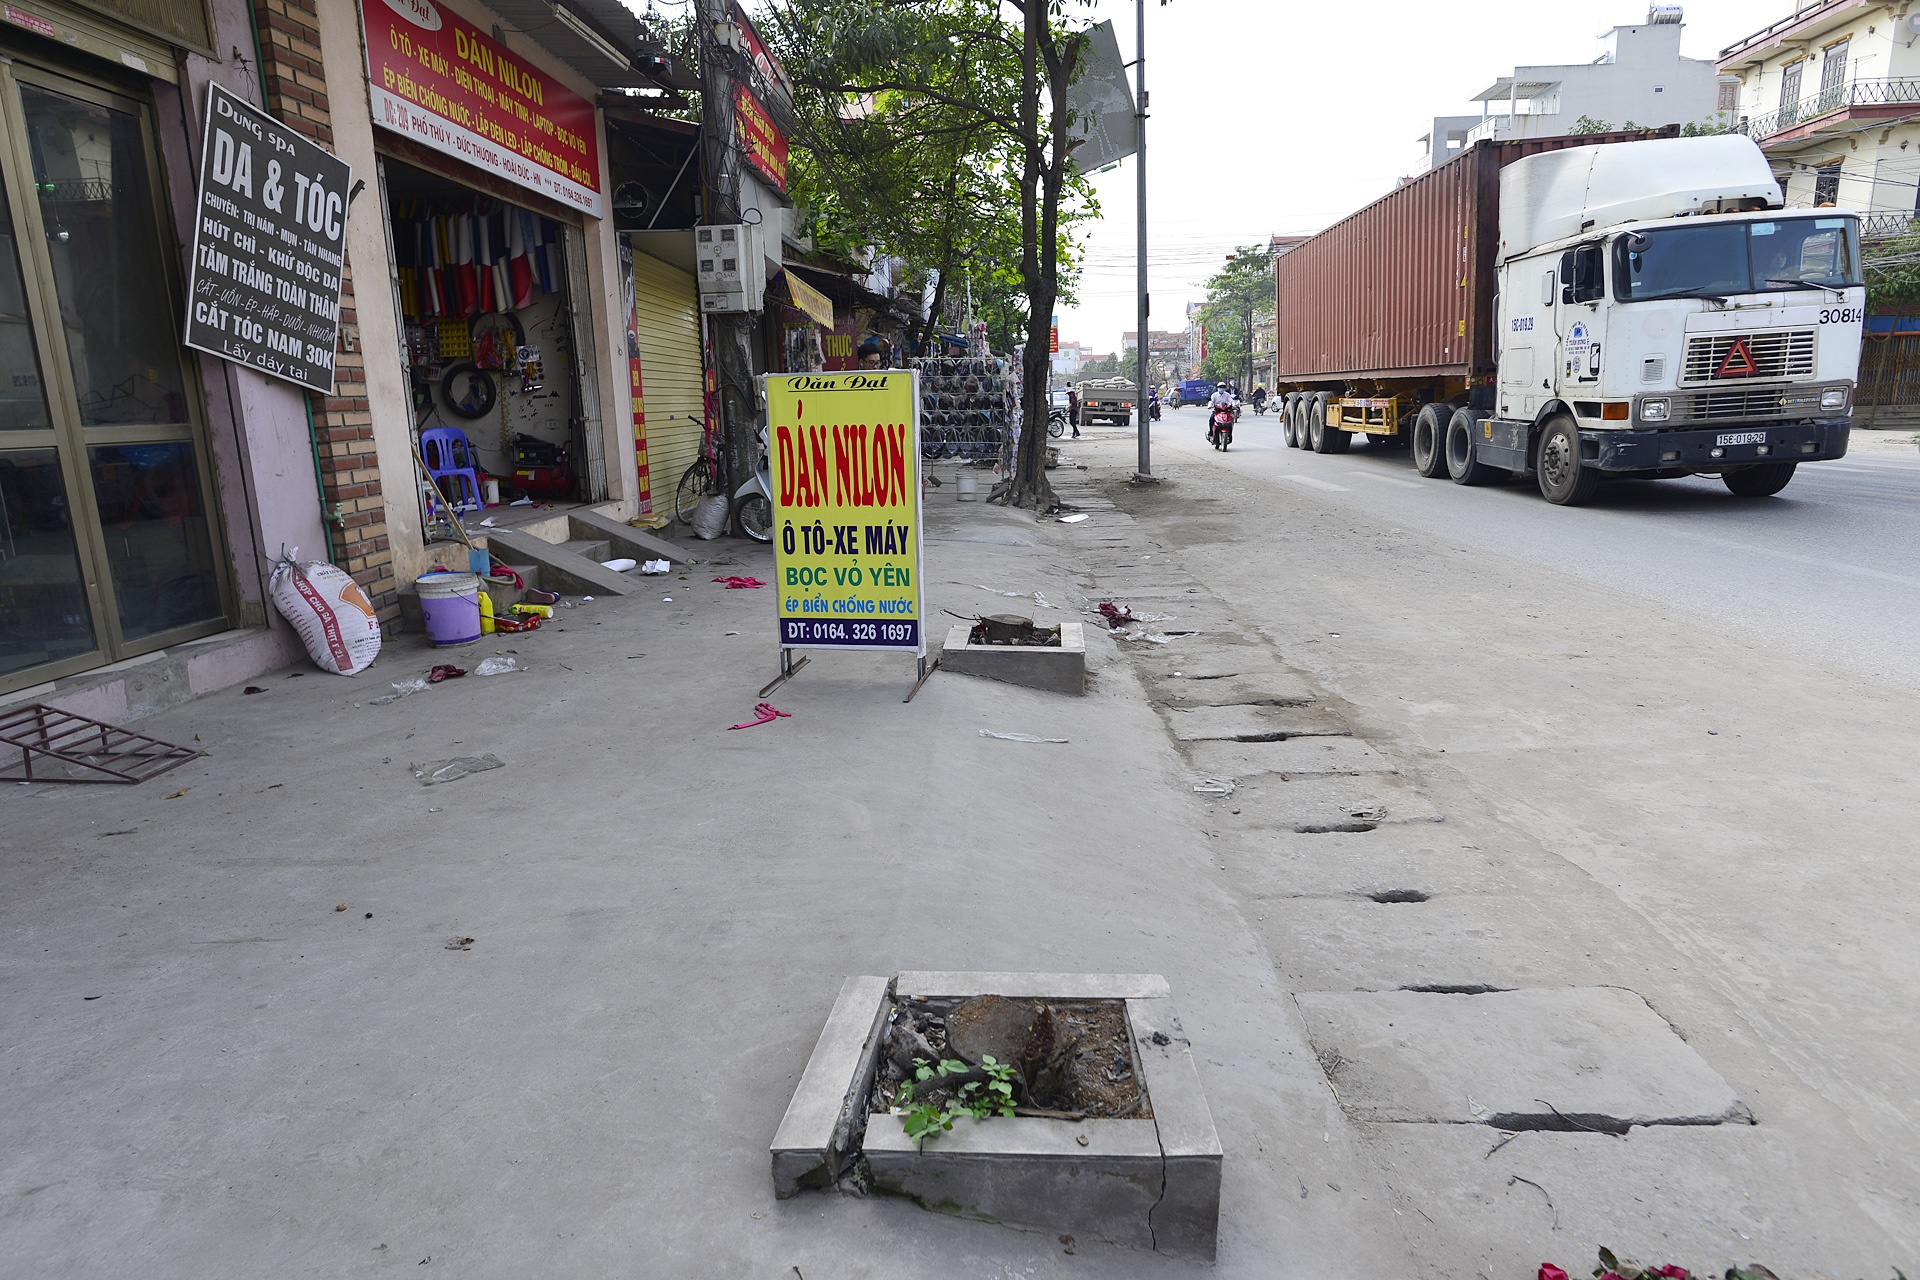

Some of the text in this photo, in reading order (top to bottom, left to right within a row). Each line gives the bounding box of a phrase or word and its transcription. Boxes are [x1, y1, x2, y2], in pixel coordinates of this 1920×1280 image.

[390, 23, 587, 155] Ô TÔ XE MÁY ĐIỆN THOẠI MÁY TÍNH LAPTOP BỌC VỎ YÊN
[454, 27, 543, 107] DÁN NILON
[383, 61, 395, 90] ÉP
[397, 67, 418, 102] BIỂN
[418, 83, 449, 117] CHỐNG
[449, 99, 471, 128] NƯỚC
[475, 106, 489, 136] LẮP
[489, 120, 504, 145] ĐÈN
[504, 129, 517, 150] LED
[520, 130, 533, 158] LẮP
[533, 141, 553, 168] CHỐNG
[212, 127, 342, 241] DA & TÓC
[411, 115, 428, 136] PHỐ
[429, 125, 444, 143] THÚ
[446, 131, 451, 146] Y
[456, 135, 472, 155] ĐỨC
[472, 143, 498, 167] THƯỢNG
[502, 157, 517, 176] HOÀI
[518, 163, 530, 181] ĐỨC
[533, 171, 542, 186] HN
[203, 216, 338, 292] HÚT CHÌ KHỬ ĐỘC DA
[205, 191, 341, 268] CHUYÊN: TRỊ NÁM MỤN TÀN NHANG
[196, 277, 219, 297] CẮT
[244, 295, 258, 313] ÉP
[261, 304, 280, 322] HẤP
[306, 323, 336, 345] NHUỘM
[199, 241, 338, 322] TẮM TRẮNG TOÀN THÂN
[1819, 308, 1862, 325] 30814
[195, 300, 334, 370] CẮT TÓC NAM 30K
[223, 339, 308, 381] Lấy dáy tai
[825, 333, 853, 362] THỰC
[787, 375, 888, 392] Văn Đạt
[777, 399, 829, 508] DÁN
[832, 423, 906, 508] NILON
[782, 519, 796, 555] Ô
[864, 519, 909, 555] MÁY
[785, 592, 913, 614] ÉP BIỂN CHỐNG NƯỚC
[786, 558, 910, 592] BỌC VỎ YÊN
[296, 580, 312, 596] HỢP
[309, 596, 325, 612] CHO
[321, 611, 333, 623] GÀ
[327, 623, 338, 641] THỊT
[335, 649, 344, 659] 21
[788, 622, 912, 641] ĐT: 0164. 326 1697
